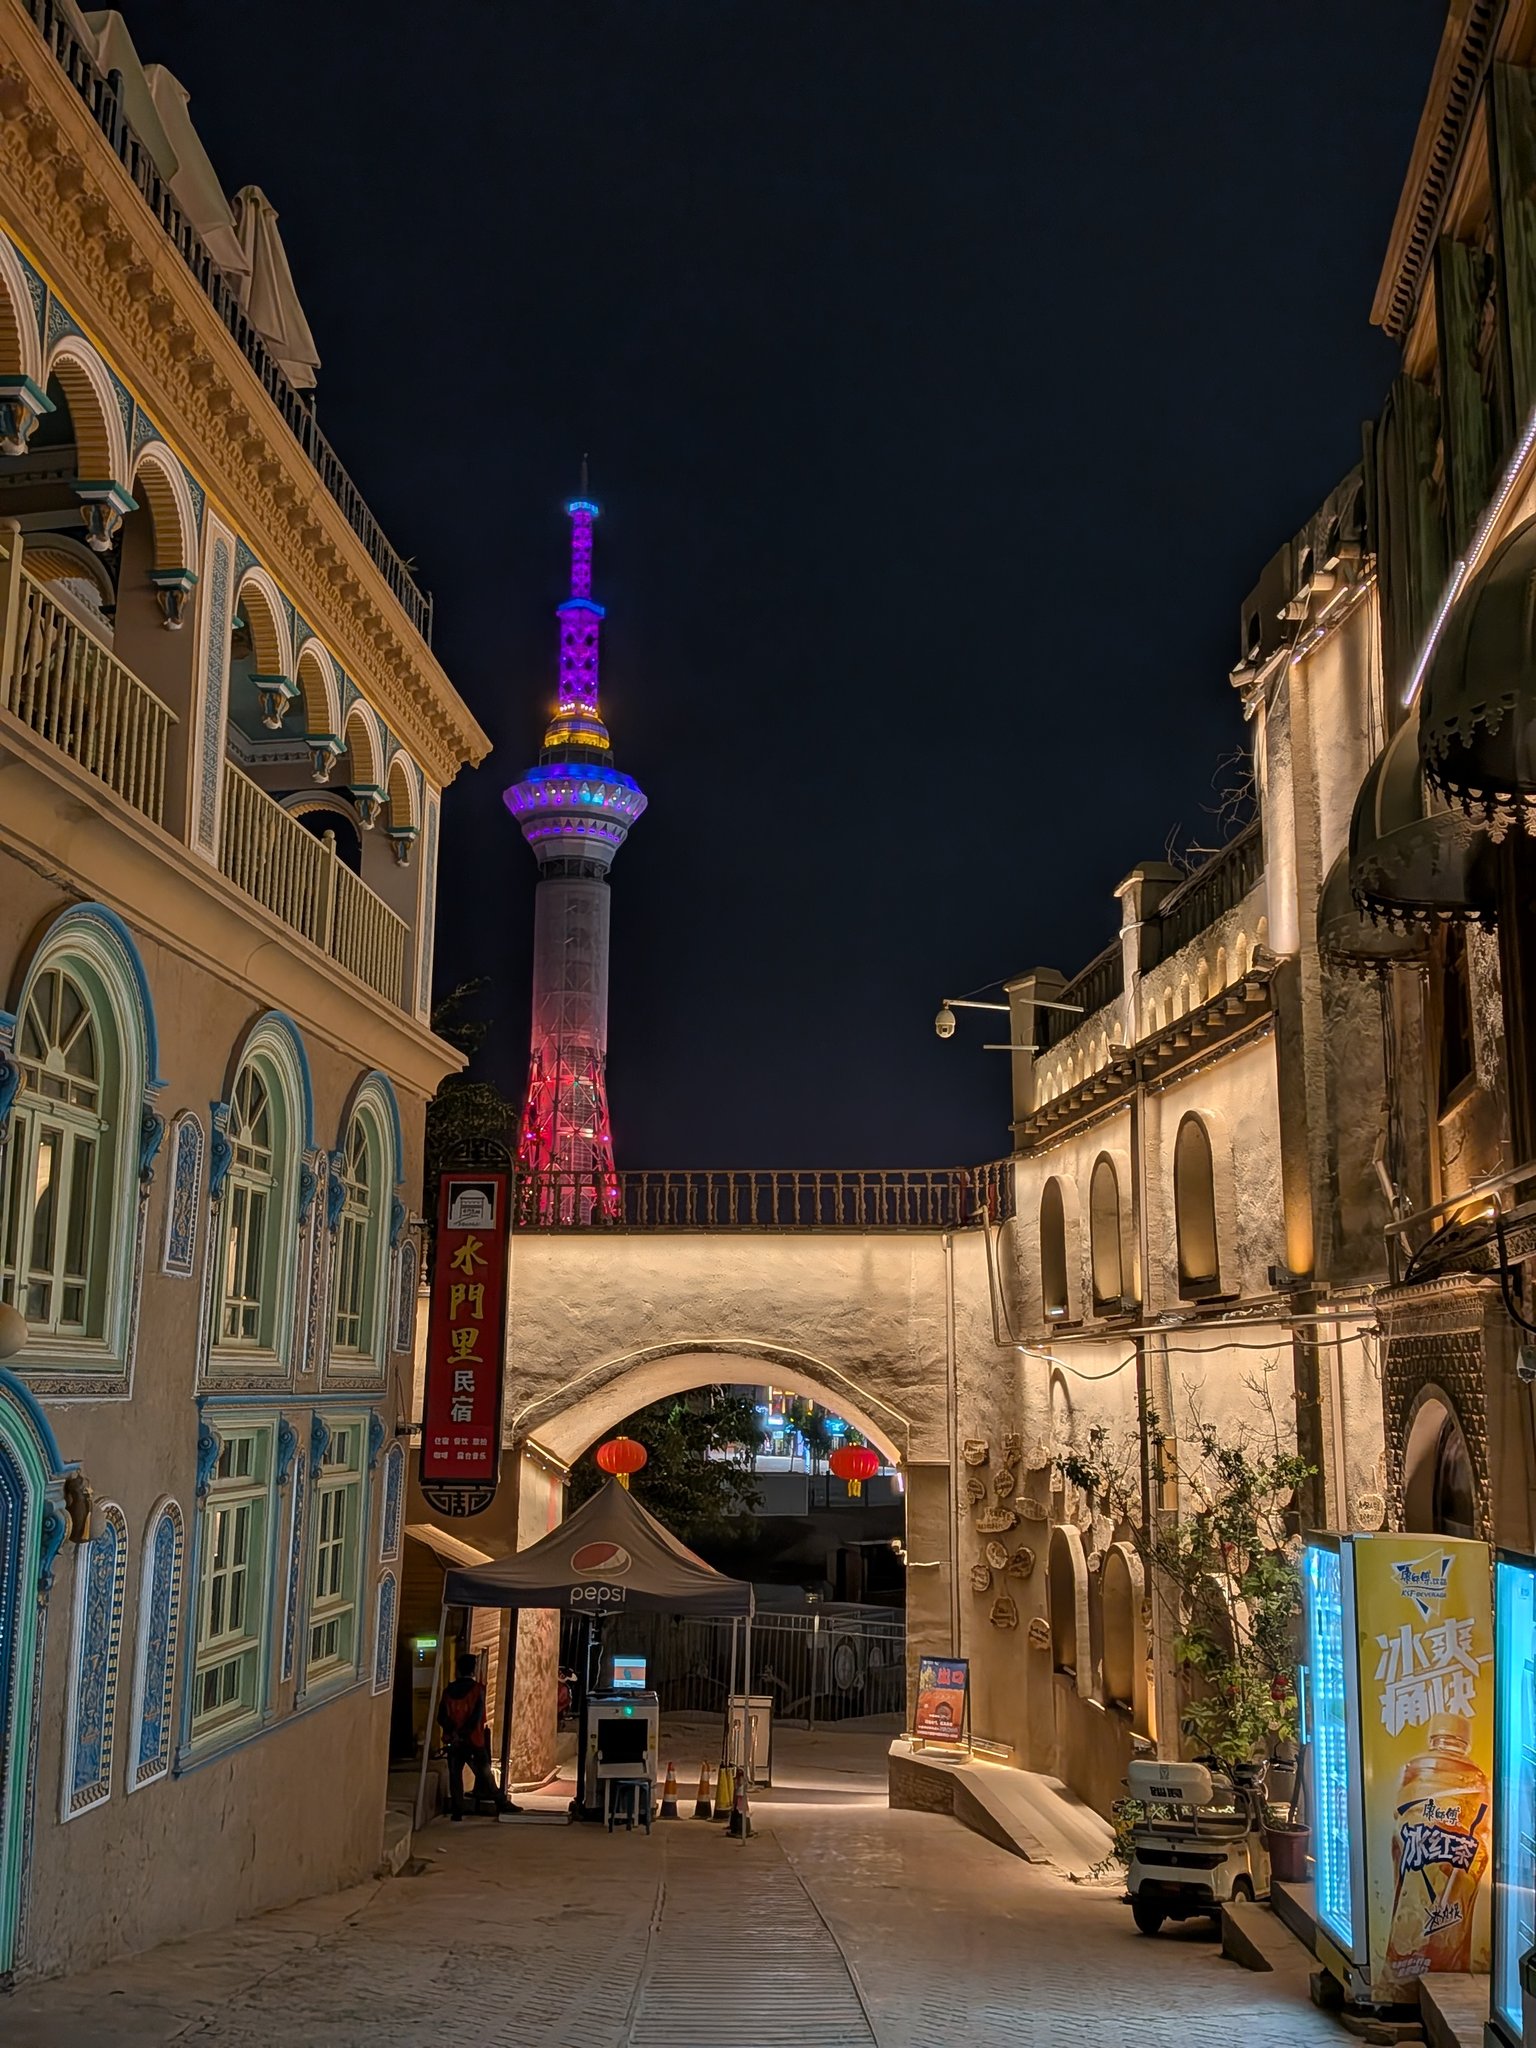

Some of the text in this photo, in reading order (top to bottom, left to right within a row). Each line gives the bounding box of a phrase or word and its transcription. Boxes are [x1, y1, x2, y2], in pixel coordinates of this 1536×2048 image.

[451, 1370, 475, 1422] 民宿
[570, 1586, 627, 1605] pepsi
[1374, 1618, 1481, 1683] 冰爽
[1378, 1669, 1477, 1737] 痛快
[1400, 1824, 1478, 1872] 冰红茶
